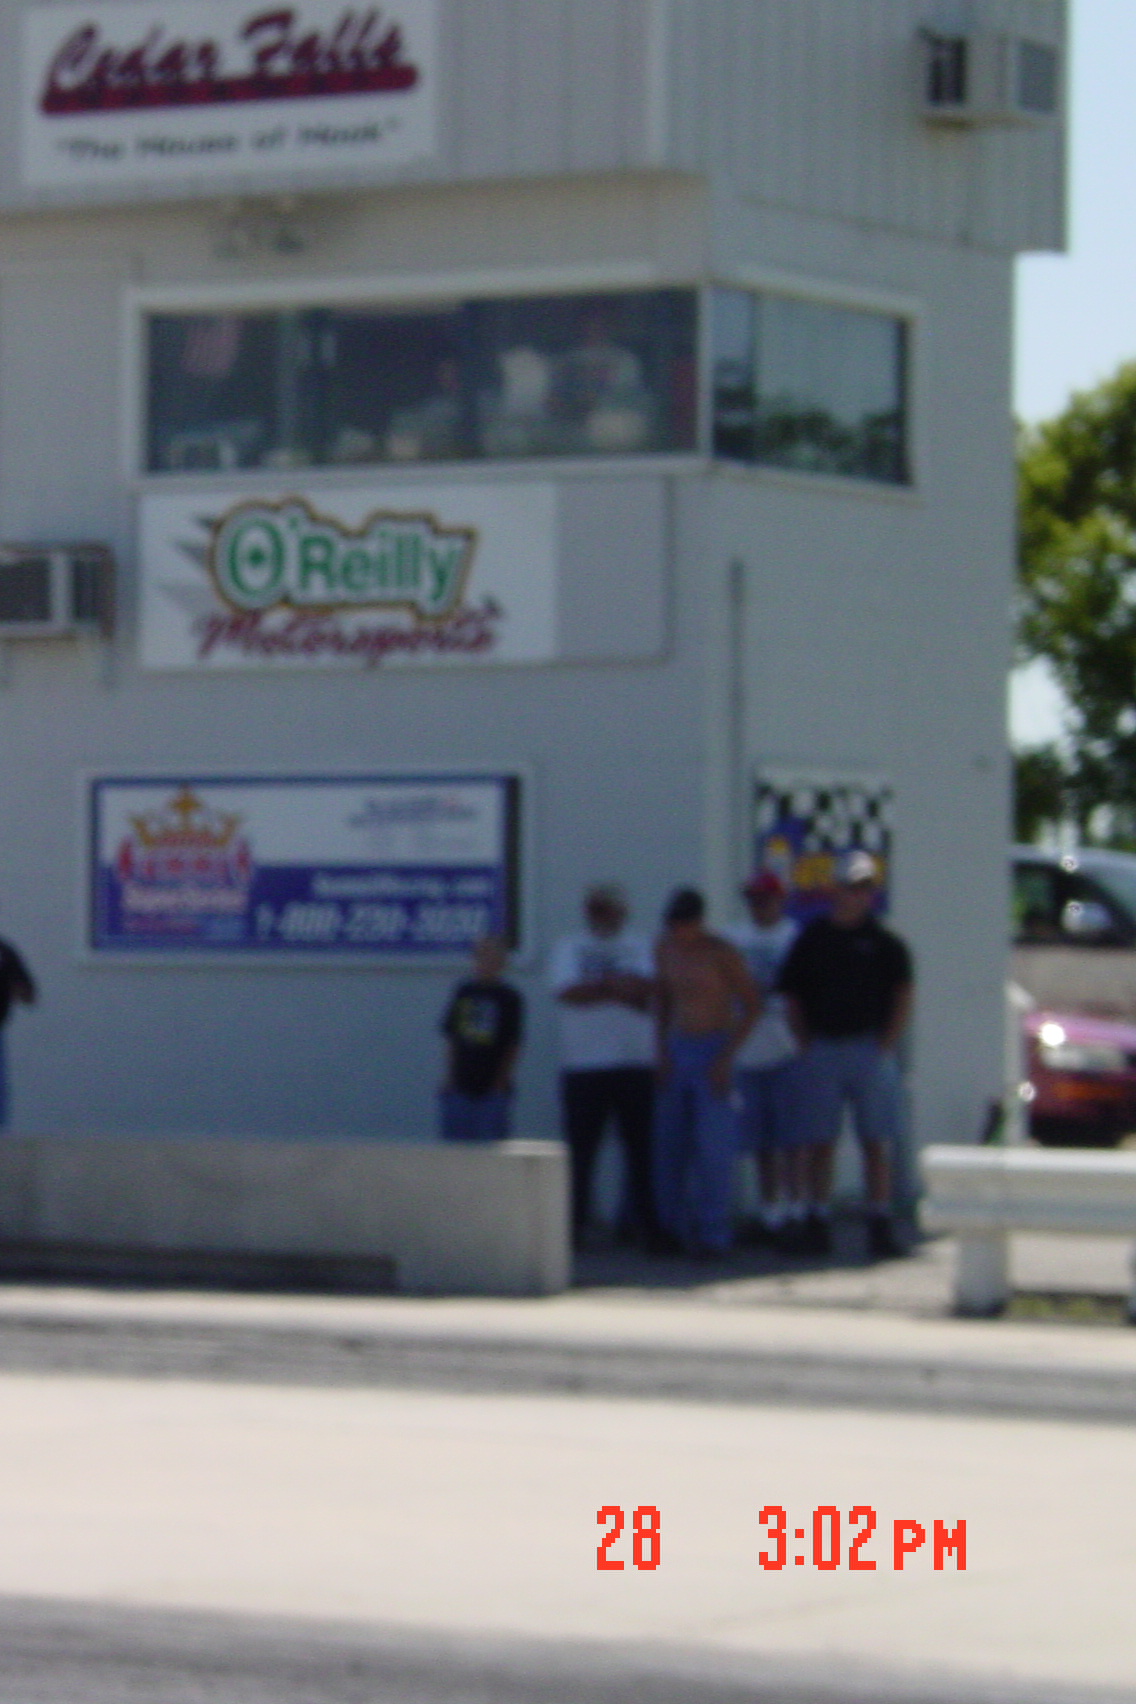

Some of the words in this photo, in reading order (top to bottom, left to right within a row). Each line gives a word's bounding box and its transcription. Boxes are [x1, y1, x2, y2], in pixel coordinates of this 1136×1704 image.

[44, 22, 221, 94] Cedar
[239, 7, 406, 84] Falls
[251, 125, 287, 151] of
[223, 513, 464, 606] O'Reilly
[195, 608, 499, 669] Motorsports
